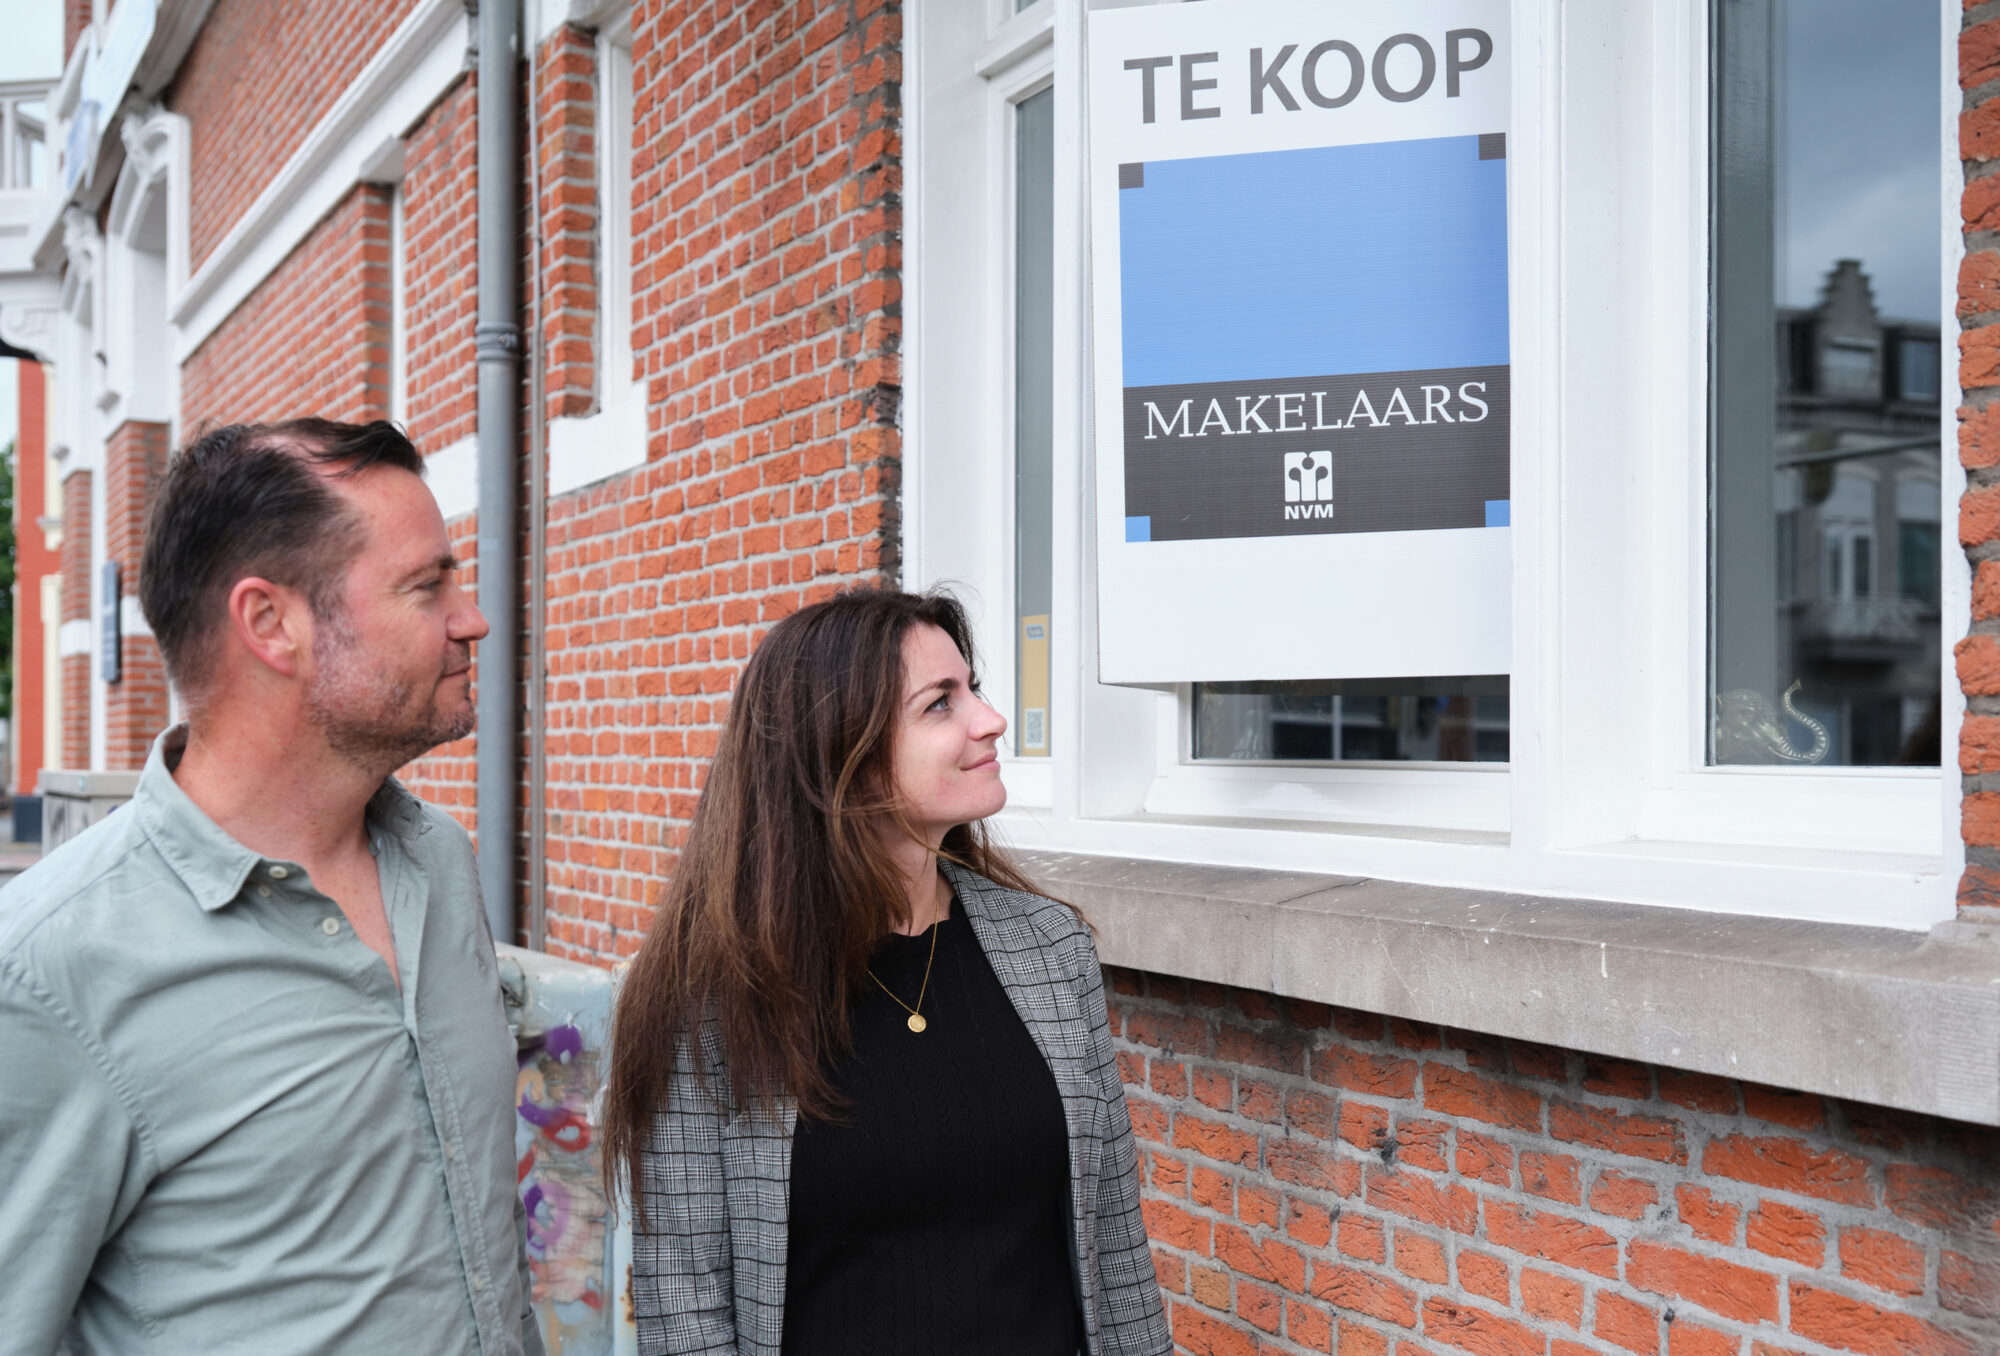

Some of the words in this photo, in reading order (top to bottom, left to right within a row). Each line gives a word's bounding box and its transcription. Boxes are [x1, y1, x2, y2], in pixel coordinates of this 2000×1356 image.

[1123, 51, 1221, 124] TE
[1249, 27, 1494, 115] KOOP
[1143, 381, 1490, 440] MAKELAARS
[1284, 503, 1334, 520] NVM
